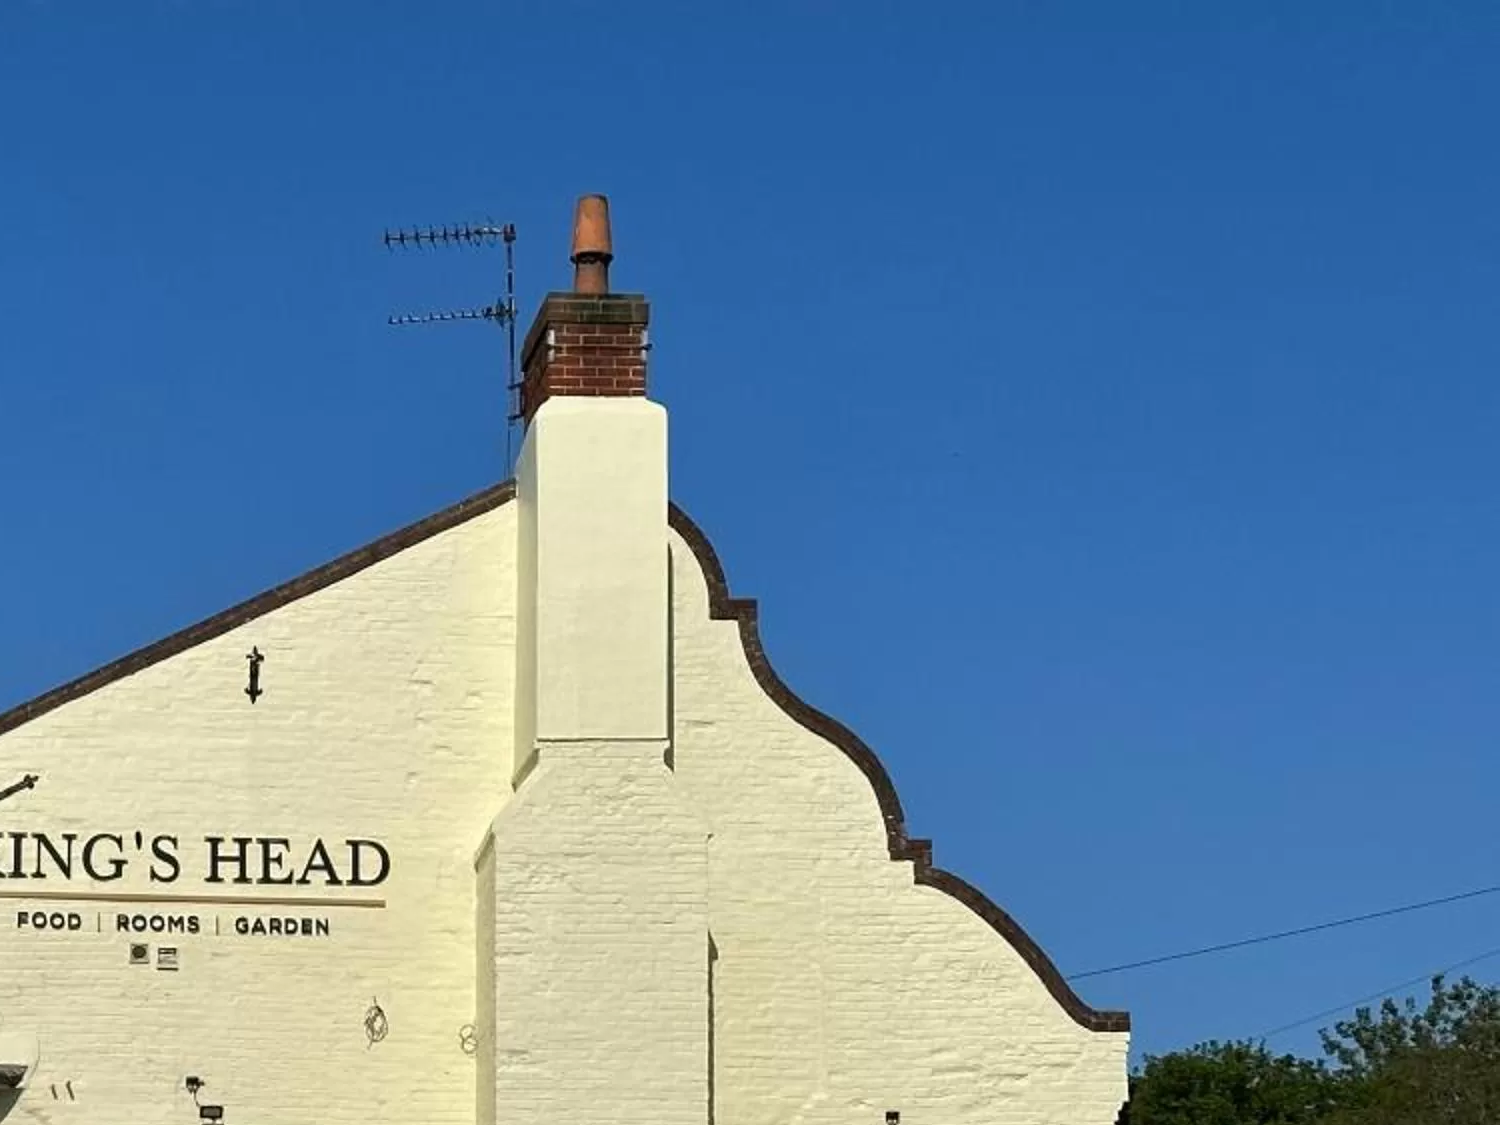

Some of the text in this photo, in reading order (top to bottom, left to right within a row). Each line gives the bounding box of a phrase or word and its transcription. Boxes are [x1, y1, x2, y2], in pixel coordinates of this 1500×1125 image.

[203, 836, 391, 887] HEAD
[16, 911, 330, 936] FOOD ROOMS GARDEN
